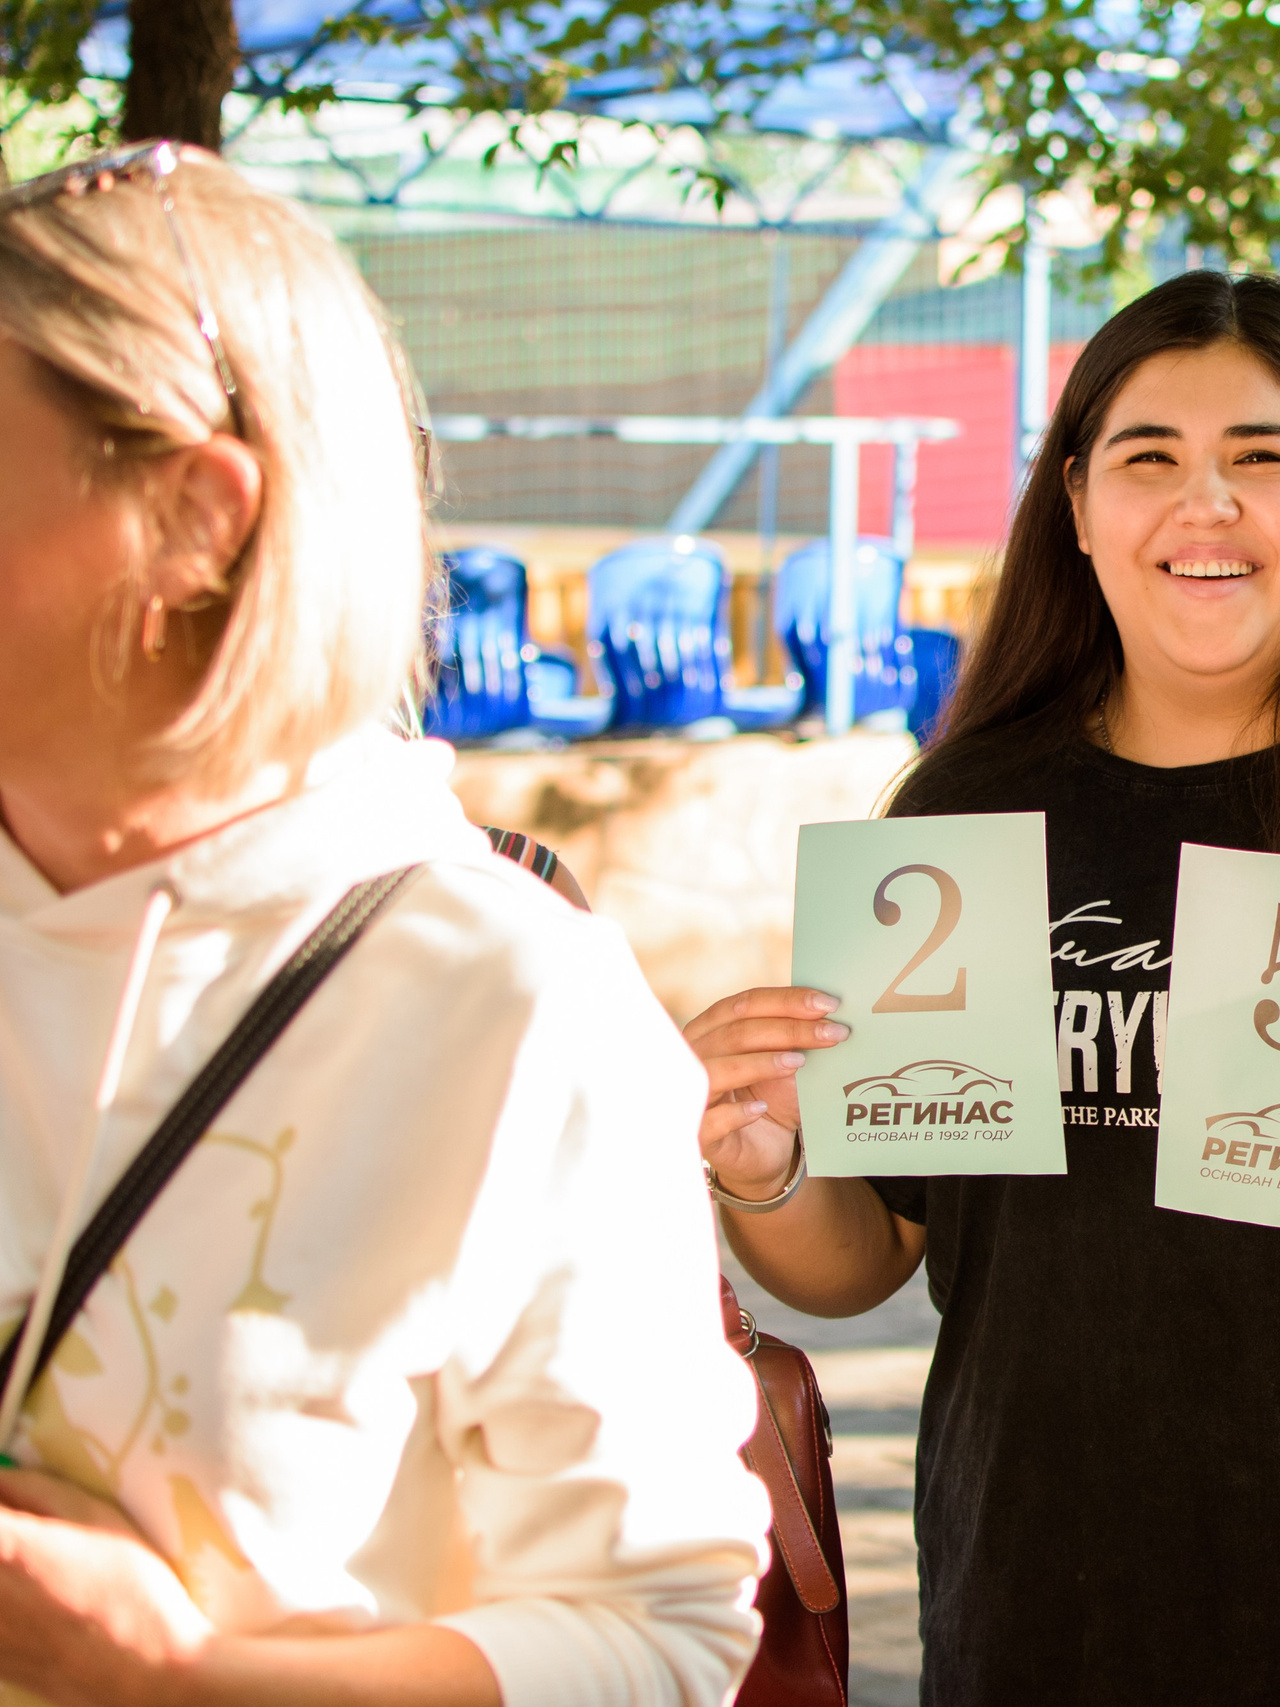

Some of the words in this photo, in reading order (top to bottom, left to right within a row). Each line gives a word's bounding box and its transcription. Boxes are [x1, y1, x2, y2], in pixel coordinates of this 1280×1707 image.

[871, 863, 967, 1014] 2
[845, 1099, 1015, 1127] РЕГИНАС
[1103, 1108, 1160, 1128] PARK
[846, 1131, 919, 1143] ОСНОВАН
[923, 1130, 934, 1141] В
[939, 1130, 969, 1141] 1992
[973, 1129, 1014, 1142] ГОДУ
[1199, 1166, 1273, 1188] ОСНОВАН
